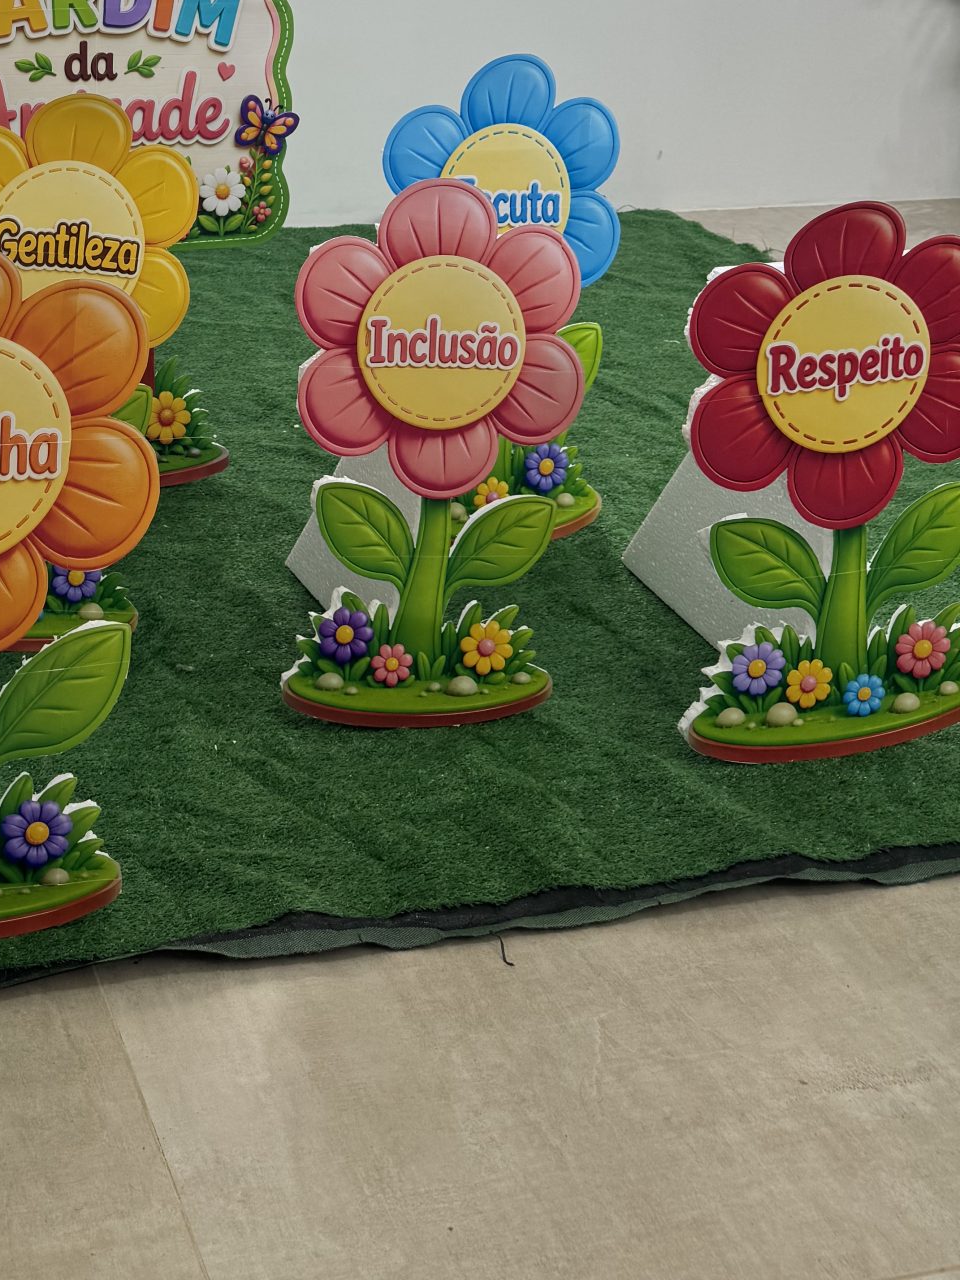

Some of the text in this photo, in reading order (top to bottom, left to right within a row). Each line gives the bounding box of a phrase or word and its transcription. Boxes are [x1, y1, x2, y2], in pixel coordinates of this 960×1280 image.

[63, 40, 118, 82] da
[458, 178, 561, 224] cuta
[370, 317, 518, 367] Inclusão
[769, 336, 925, 398] Respeito
